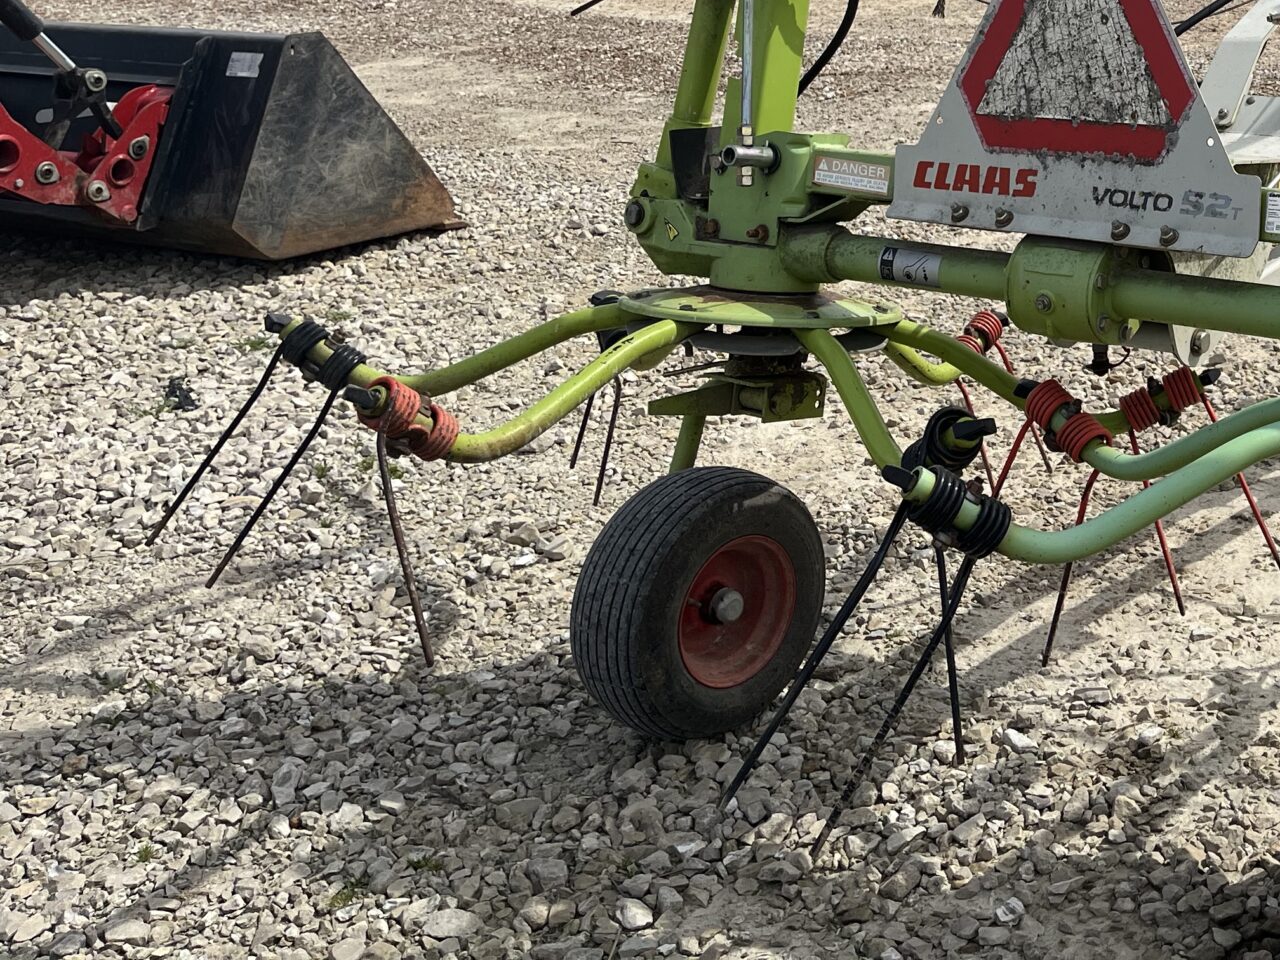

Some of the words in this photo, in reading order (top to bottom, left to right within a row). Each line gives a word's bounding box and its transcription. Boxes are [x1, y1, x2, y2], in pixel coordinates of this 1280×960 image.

[832, 160, 885, 178] DANGER
[913, 161, 1039, 198] CLAAS
[1092, 186, 1174, 212] VOLTO
